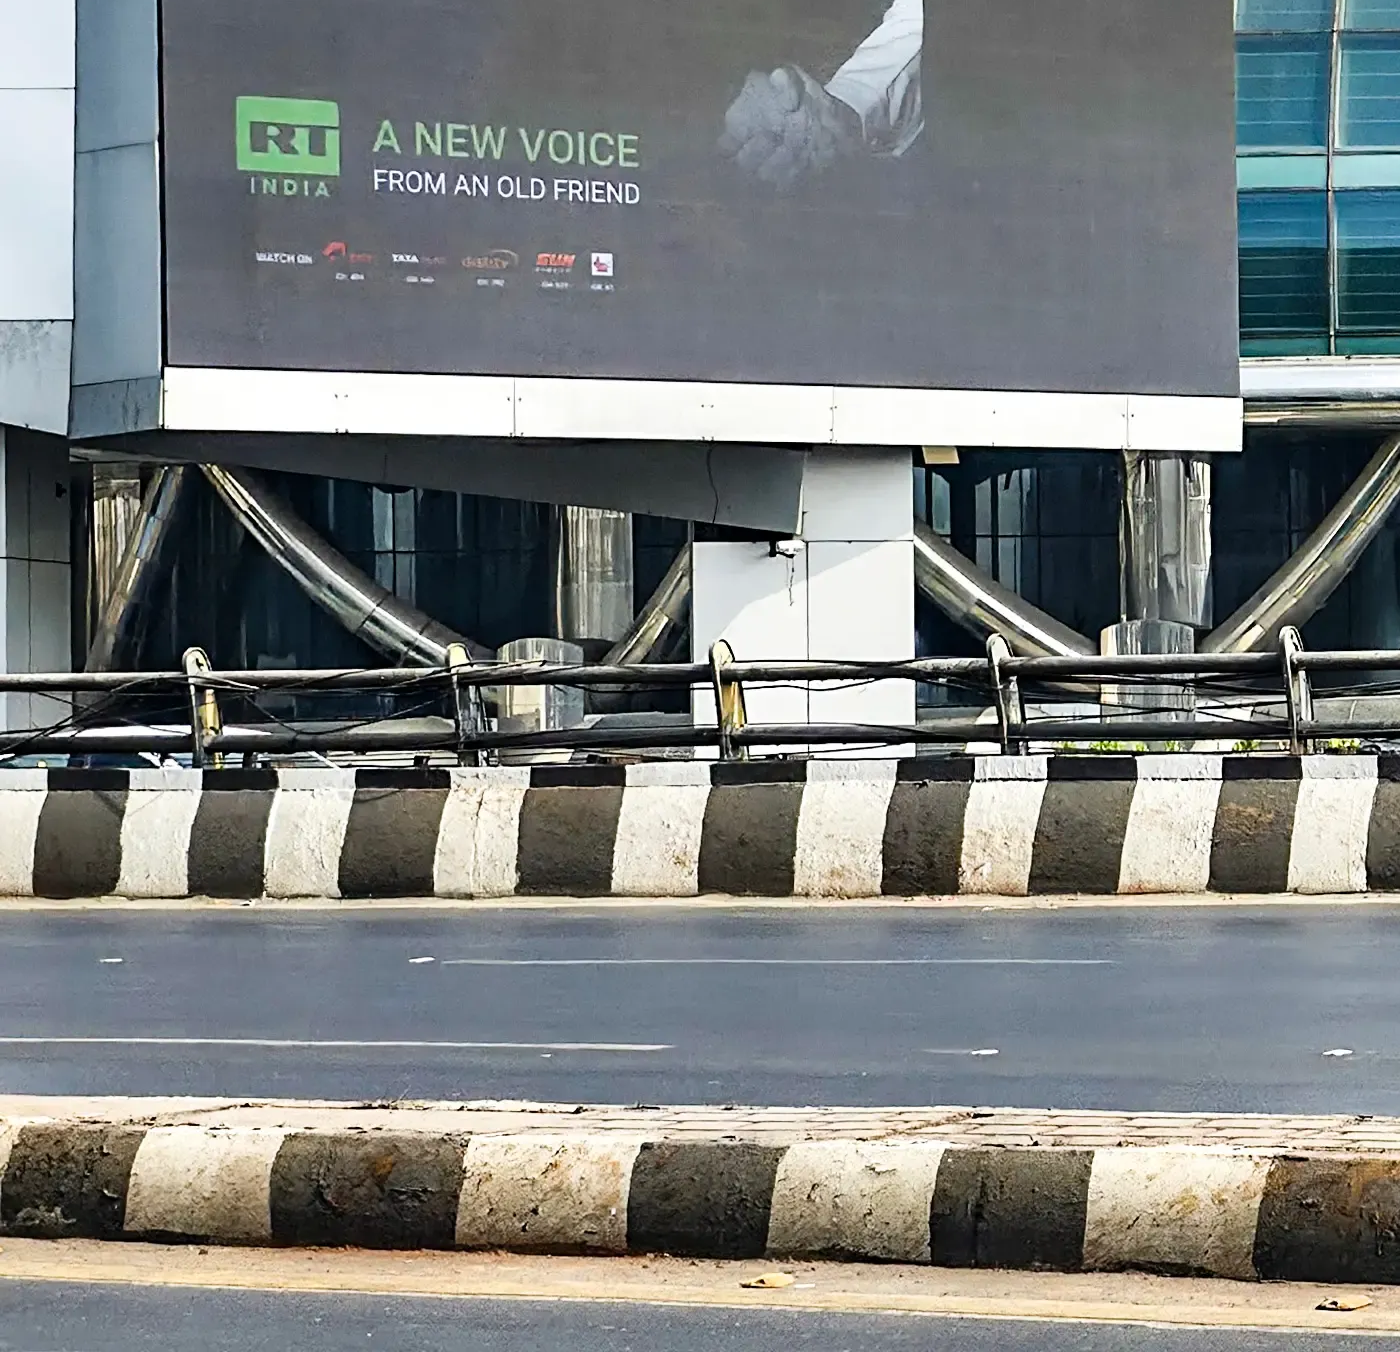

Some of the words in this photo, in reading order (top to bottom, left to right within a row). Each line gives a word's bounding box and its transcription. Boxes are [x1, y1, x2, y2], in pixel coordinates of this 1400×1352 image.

[250, 121, 339, 156] RT
[373, 120, 402, 154] A
[415, 121, 507, 161] NEW
[518, 127, 640, 167] VOICE
[251, 176, 331, 197] INDIA
[373, 168, 446, 195] FROM
[454, 173, 489, 197] AN
[497, 175, 546, 199] OLD
[553, 179, 640, 204] FRIEND
